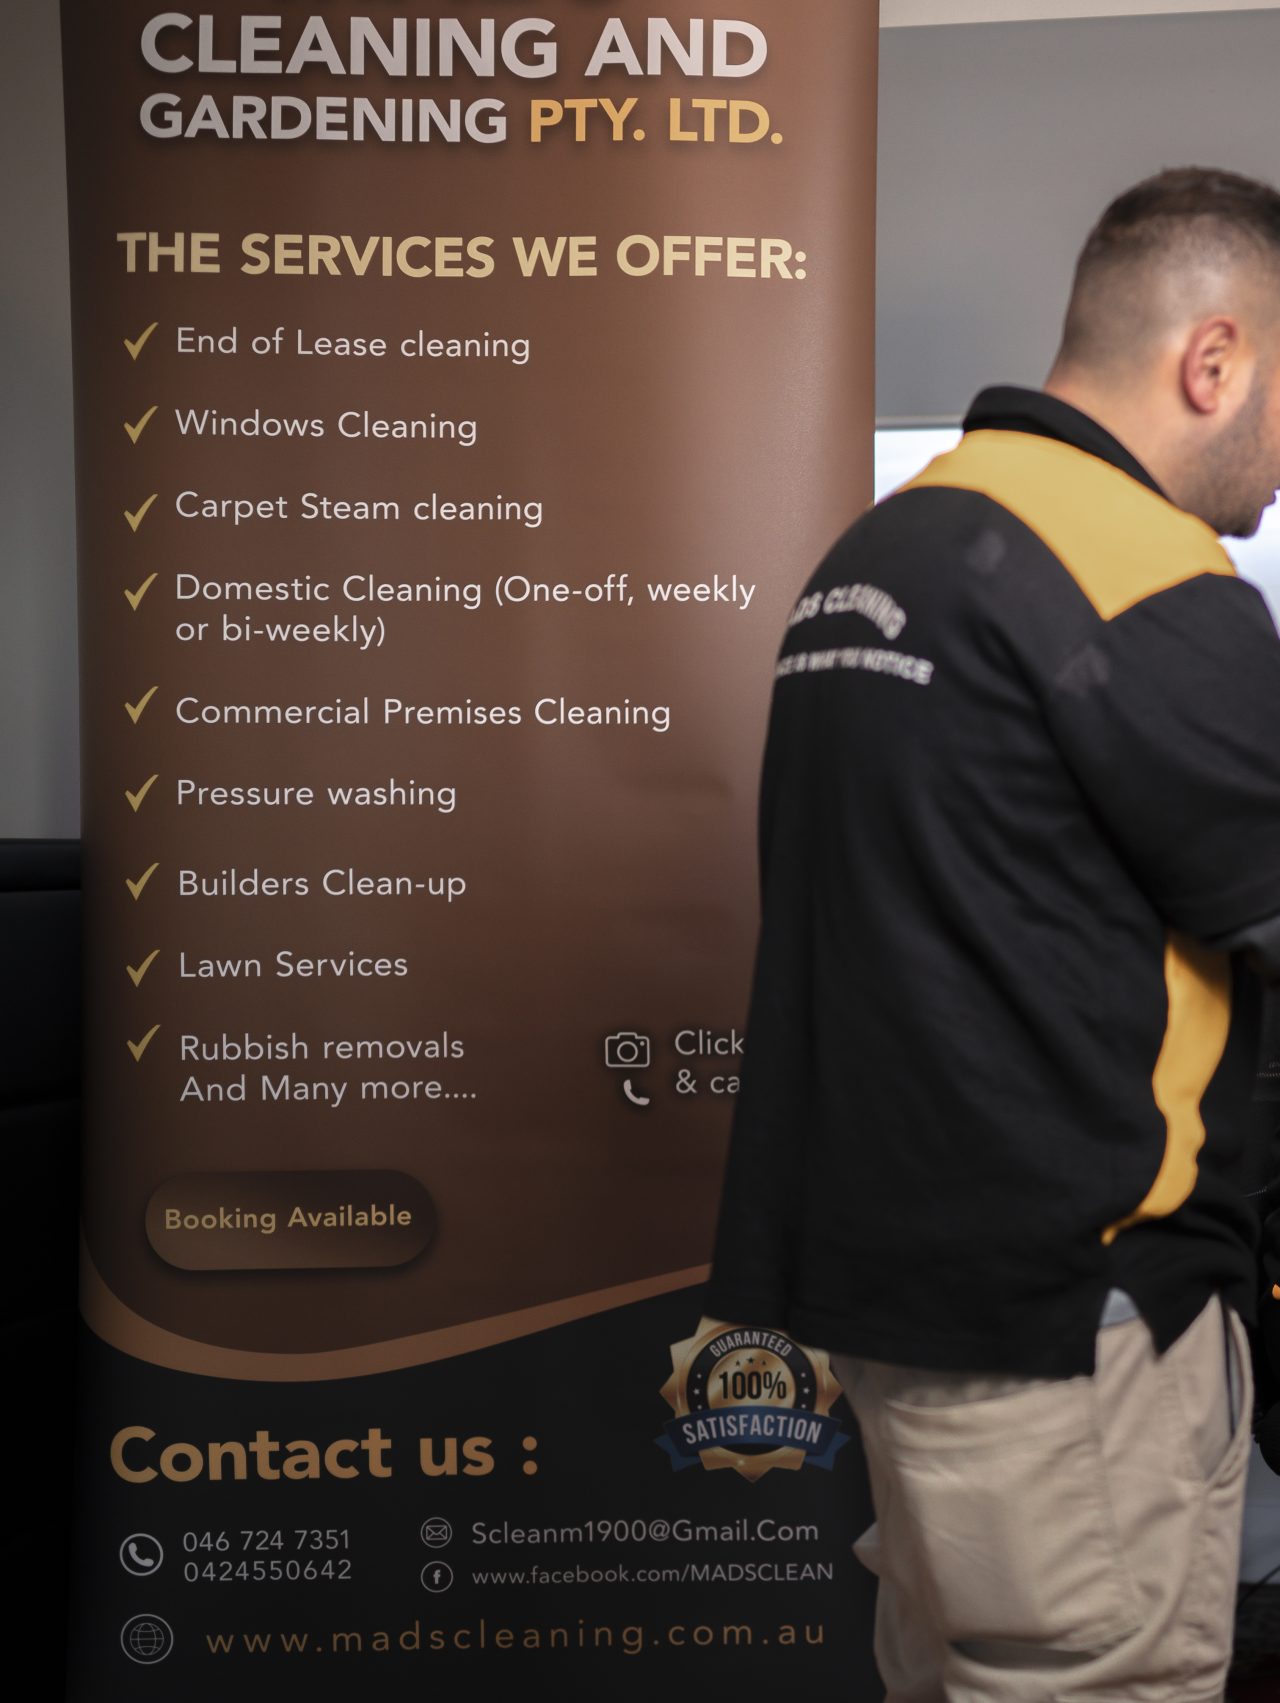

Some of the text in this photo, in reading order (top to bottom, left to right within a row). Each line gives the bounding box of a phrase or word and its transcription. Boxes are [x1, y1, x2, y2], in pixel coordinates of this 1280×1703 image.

[141, 12, 768, 79] CLEANING AND
[140, 92, 784, 145] GARDENING PTY. LTD.
[116, 231, 807, 280] THE SERVICES WE OFFER:
[177, 326, 530, 365] End of Lease cleaning
[174, 408, 477, 447] Windows Cleaning
[175, 490, 543, 529] Carpet Steam cleaning
[176, 573, 756, 611] Domestic Cleaning (One-off, weekly
[175, 613, 385, 651] or bi-weekly)
[176, 696, 670, 733] Commercial Premises Cleaning
[177, 777, 456, 814] Pressure washing
[179, 867, 466, 903] Builders Clean-up
[180, 950, 408, 978] Lawn Services
[181, 1030, 464, 1061] Rubbish removals
[674, 1028, 744, 1056] Click
[179, 1073, 246, 1102] And
[261, 1074, 348, 1108] Many
[675, 1068, 697, 1094] &
[165, 1203, 412, 1235] Booking Available
[709, 1331, 793, 1357] GUARANTEED
[719, 1371, 787, 1400] 100%
[682, 1414, 823, 1444] SATISFACTION
[110, 1425, 393, 1484] Contact
[419, 1436, 495, 1477] us
[182, 1529, 349, 1553] 046 724 7351
[471, 1518, 819, 1545] Scleanm1900@Gmail.Com
[183, 1559, 352, 1583] 0424550642
[472, 1562, 833, 1585] www.facebook.com/MADSCLEAN
[205, 1618, 824, 1655] www.madscleaning.com.au
